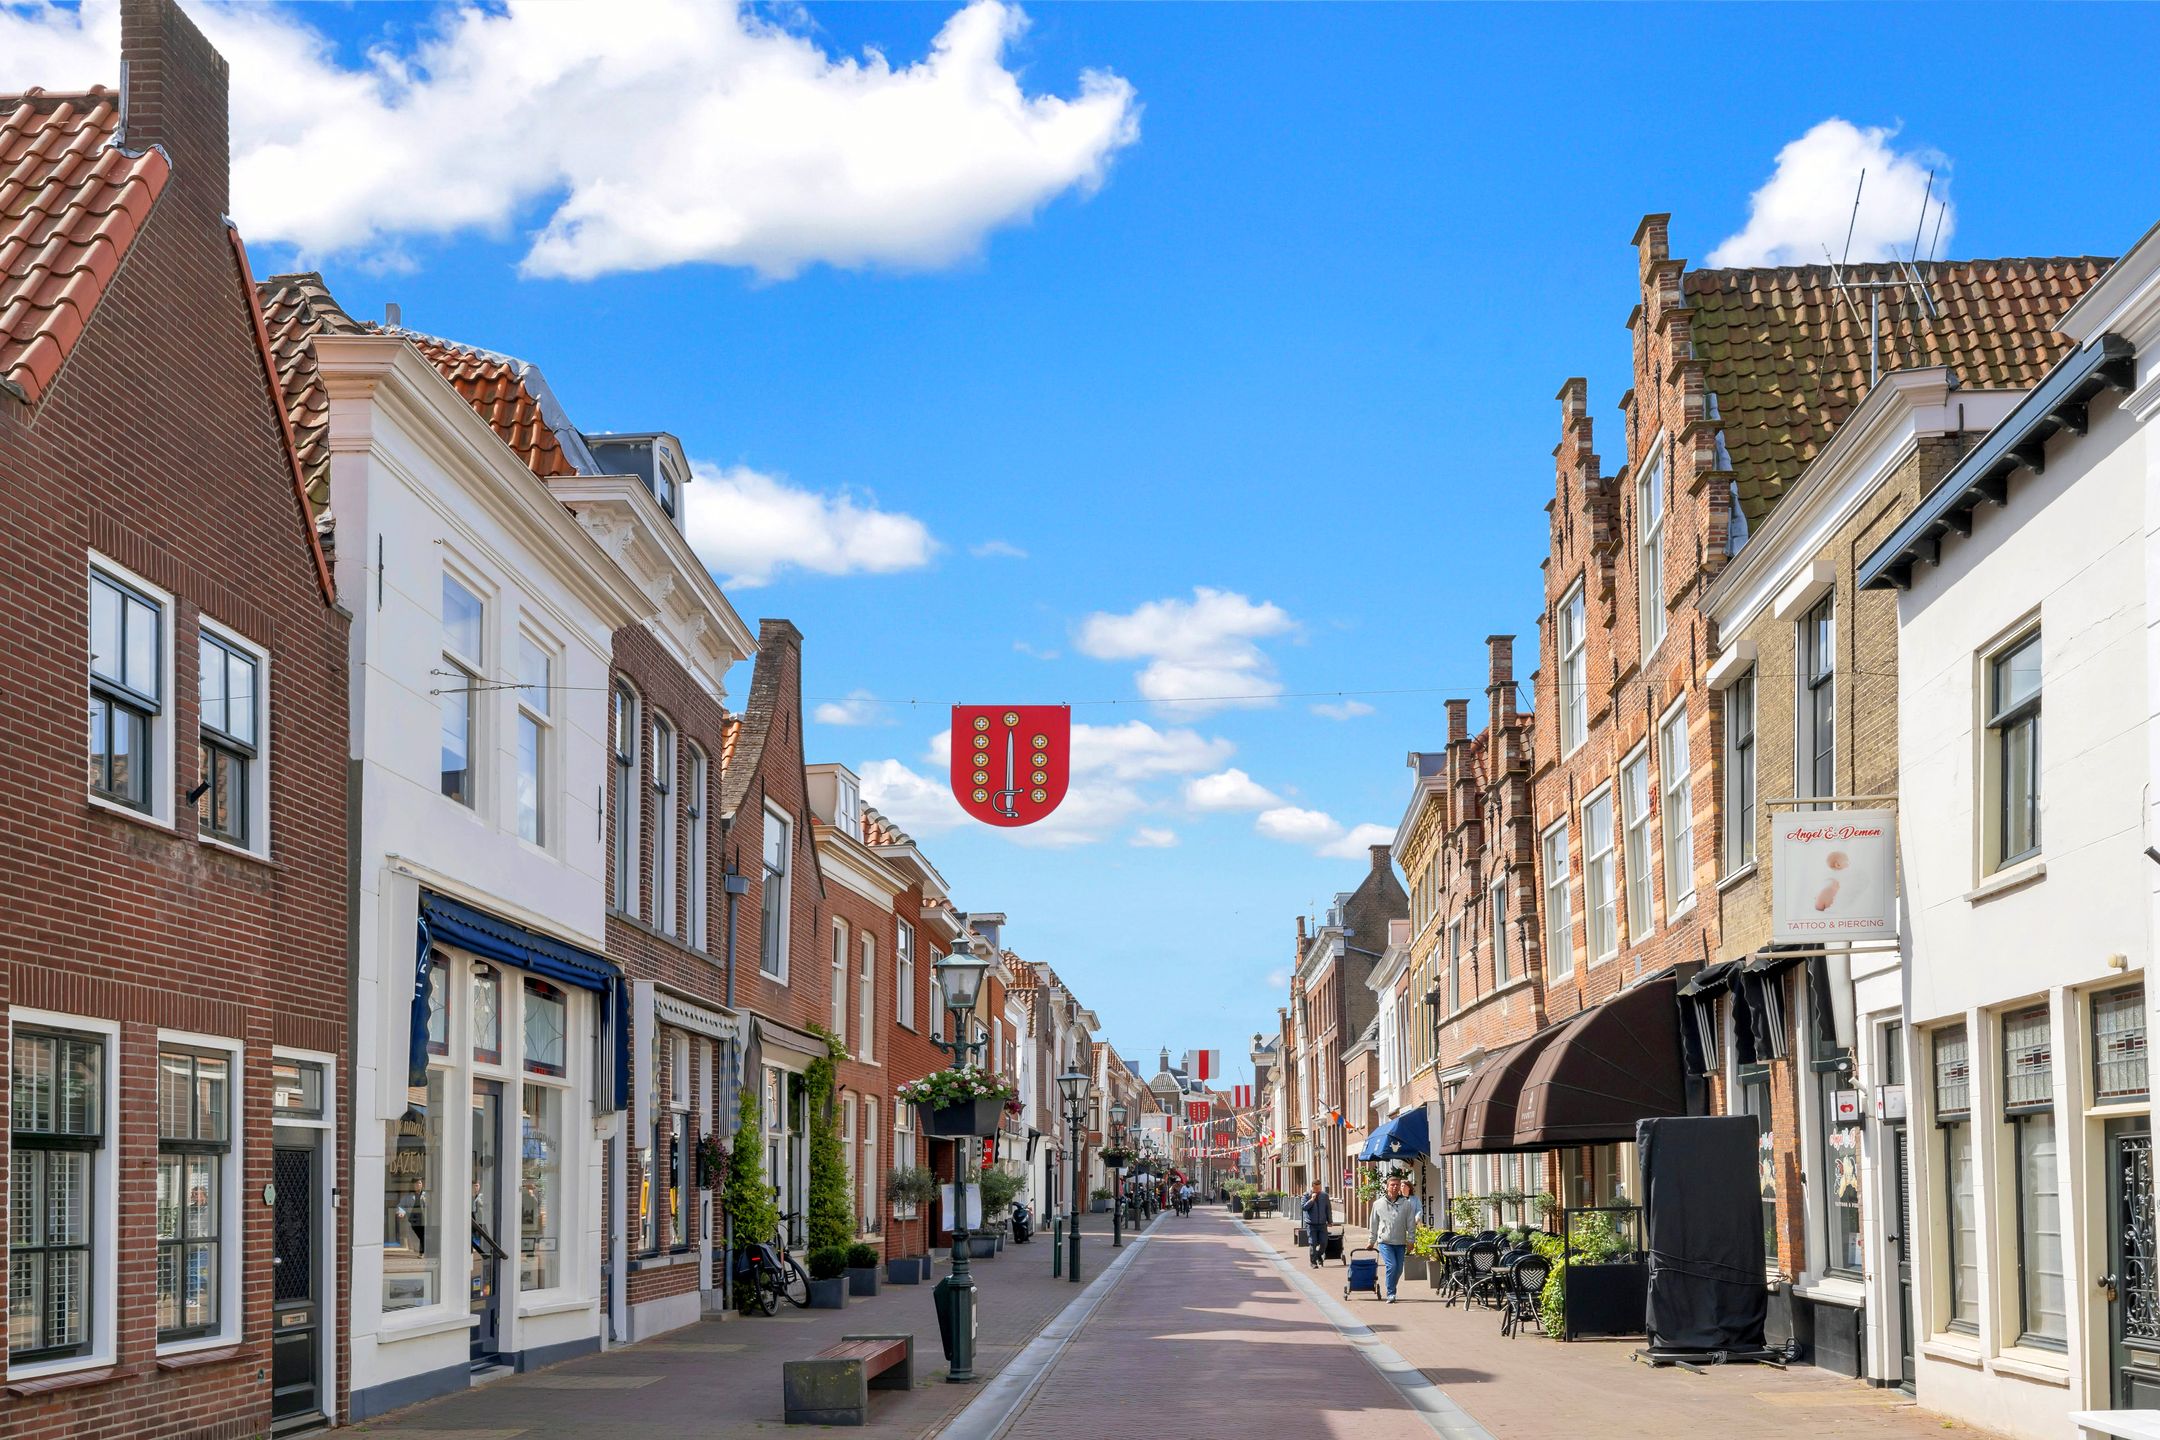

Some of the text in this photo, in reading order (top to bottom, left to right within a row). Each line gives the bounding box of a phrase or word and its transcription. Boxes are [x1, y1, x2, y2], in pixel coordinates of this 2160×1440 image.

[1786, 827, 1823, 843] Angel
[1838, 825, 1881, 840] Demon
[1787, 918, 1884, 931] TATTOO & PIERCING
